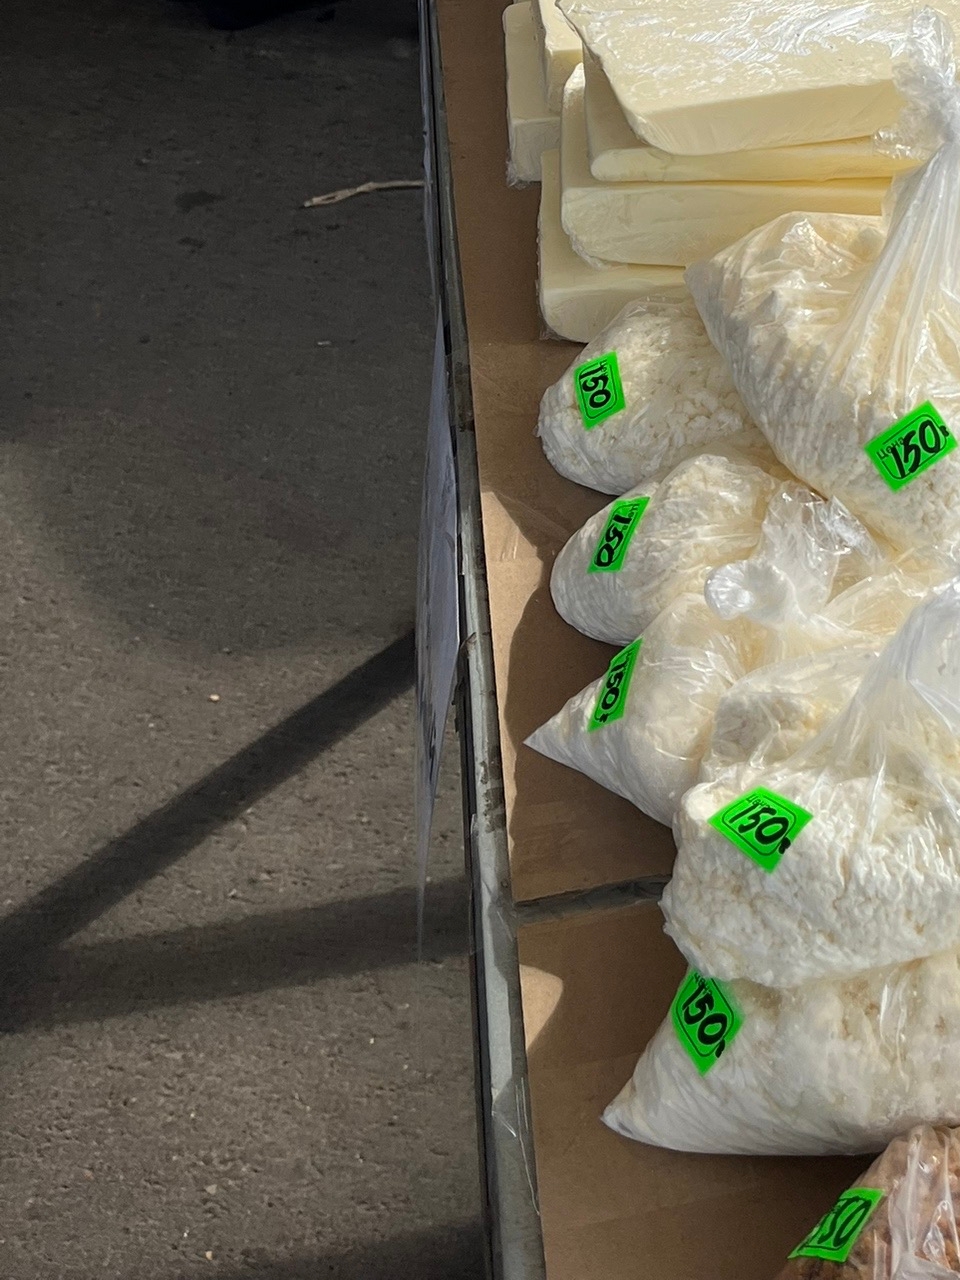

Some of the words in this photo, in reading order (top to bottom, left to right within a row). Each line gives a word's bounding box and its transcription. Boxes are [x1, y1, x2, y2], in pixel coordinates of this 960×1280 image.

[579, 364, 612, 409] 150
[890, 419, 941, 479] 150
[594, 514, 633, 568] 150
[600, 660, 627, 711] 150
[728, 802, 789, 846] 150
[681, 983, 728, 1046] 150
